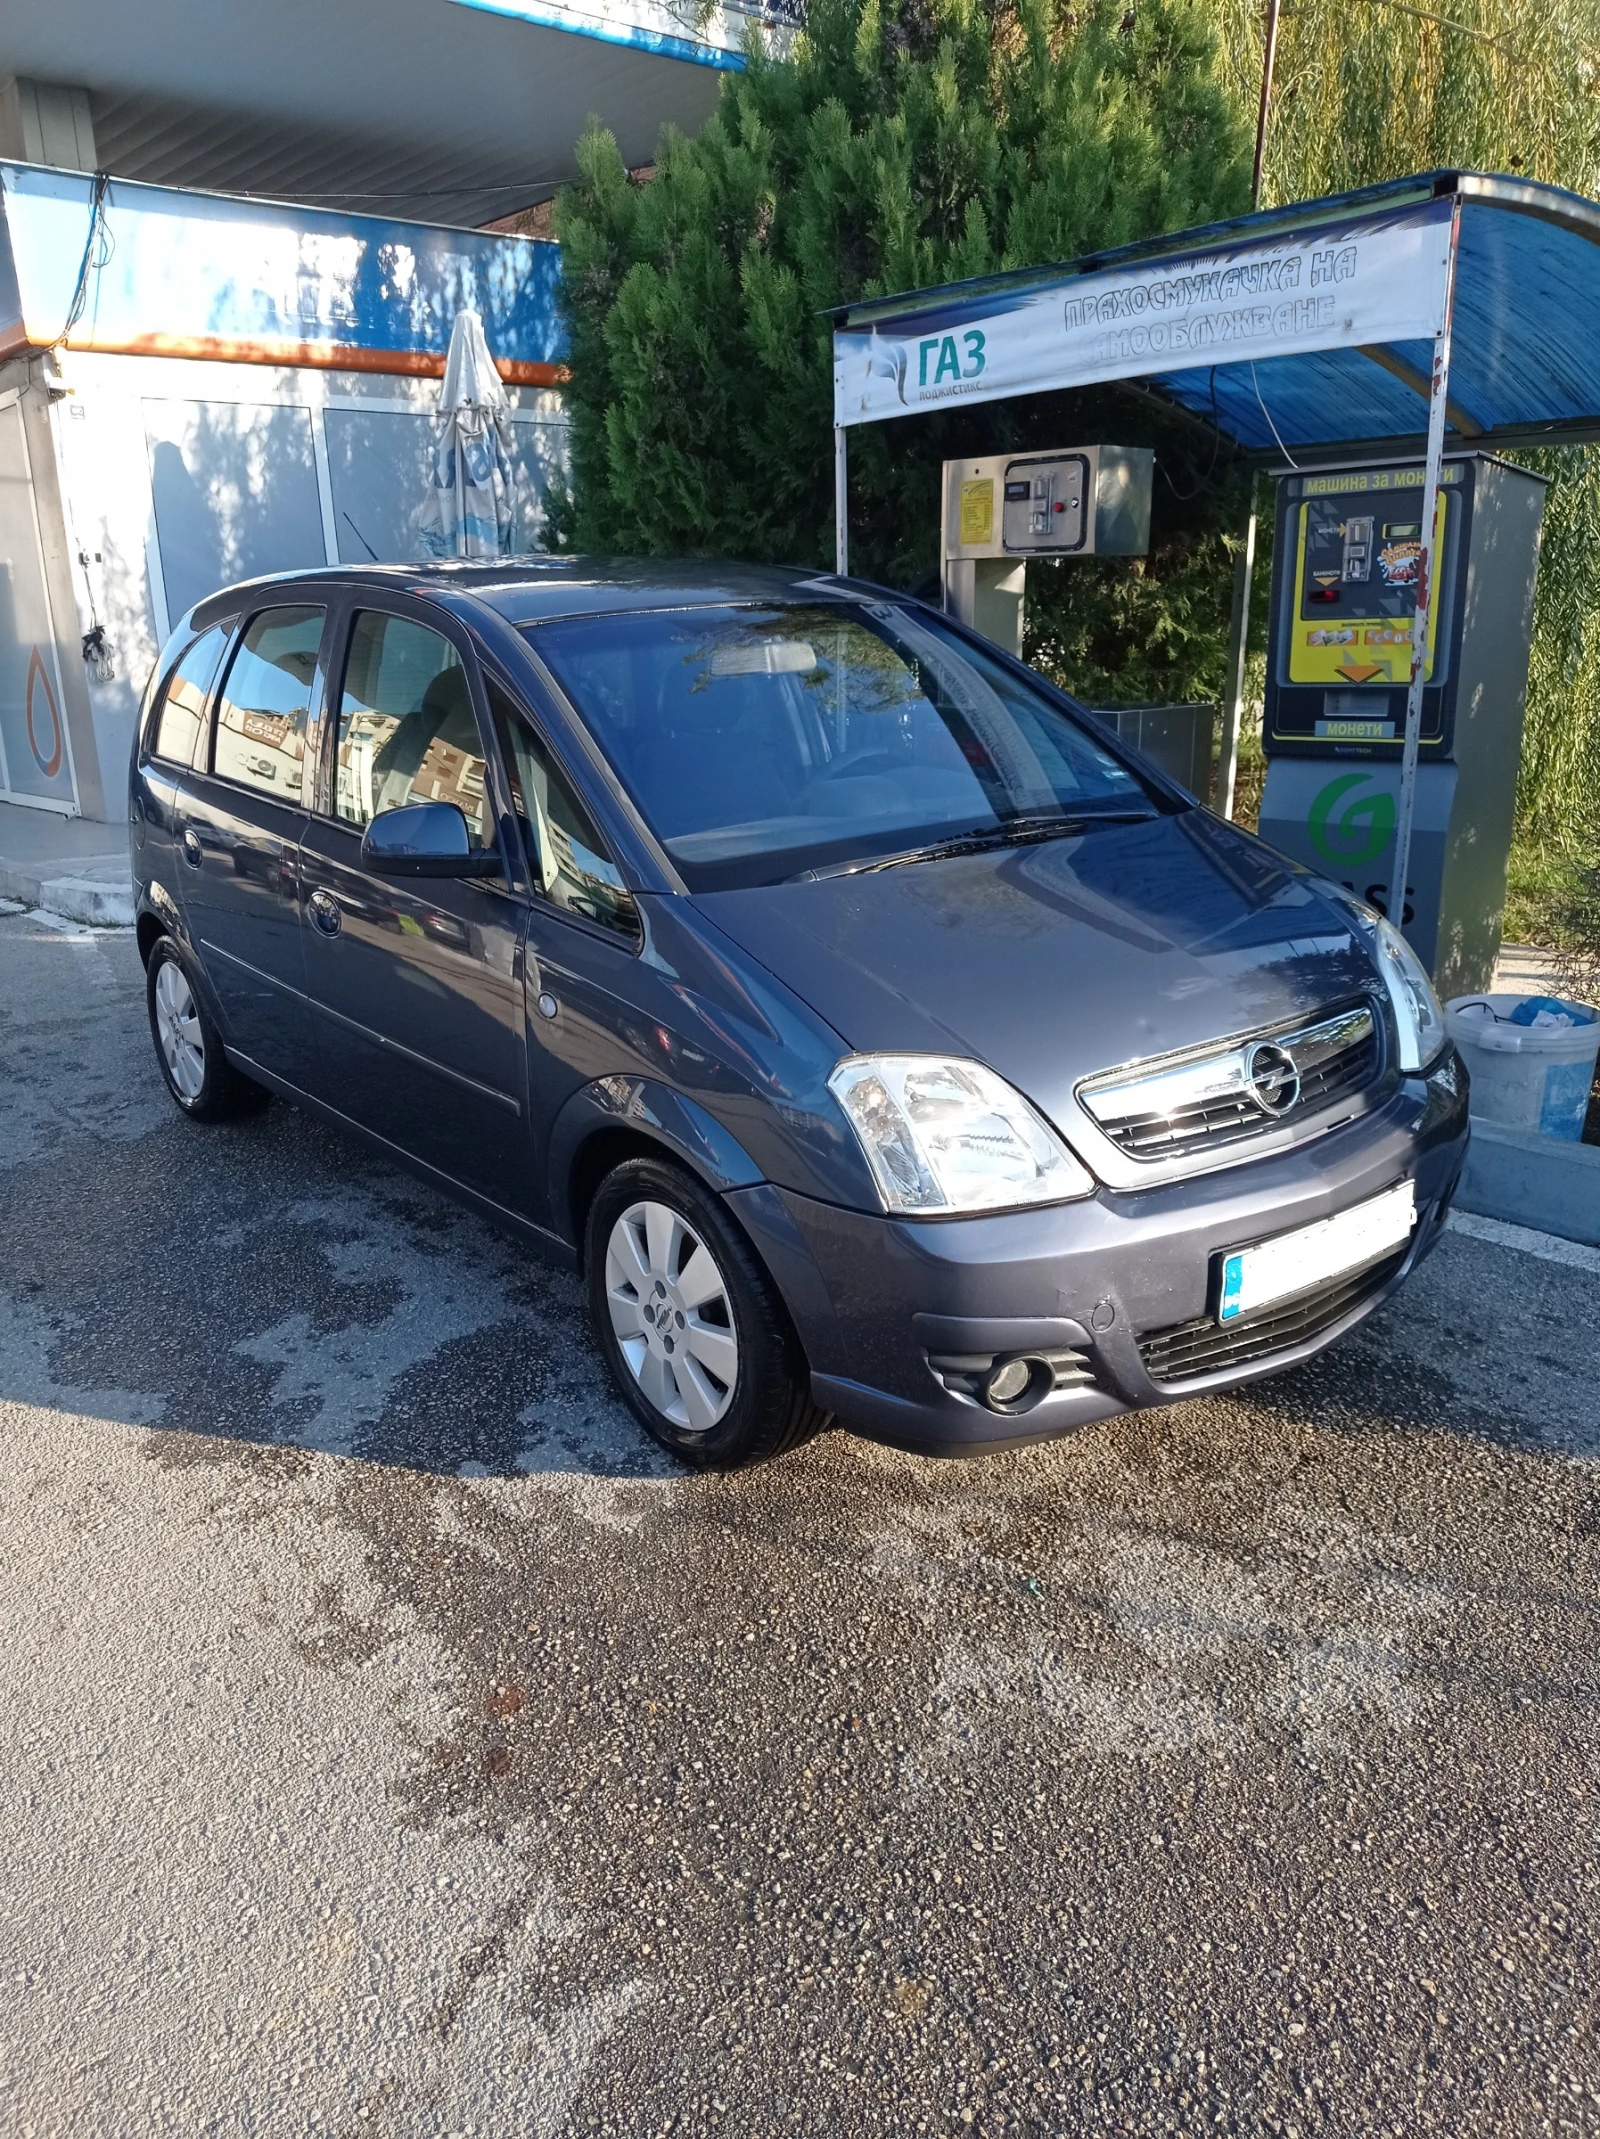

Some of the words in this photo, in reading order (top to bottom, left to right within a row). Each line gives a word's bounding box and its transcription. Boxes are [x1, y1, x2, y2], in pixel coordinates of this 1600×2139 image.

[1064, 256, 1302, 332] ПРАХОСМУКАЧКА
[1311, 245, 1358, 288] НА
[918, 329, 986, 388] ГАЗ
[1307, 476, 1368, 495] машина
[1372, 473, 1389, 489] за
[1394, 467, 1454, 487] мони
[1326, 722, 1384, 737] монети
